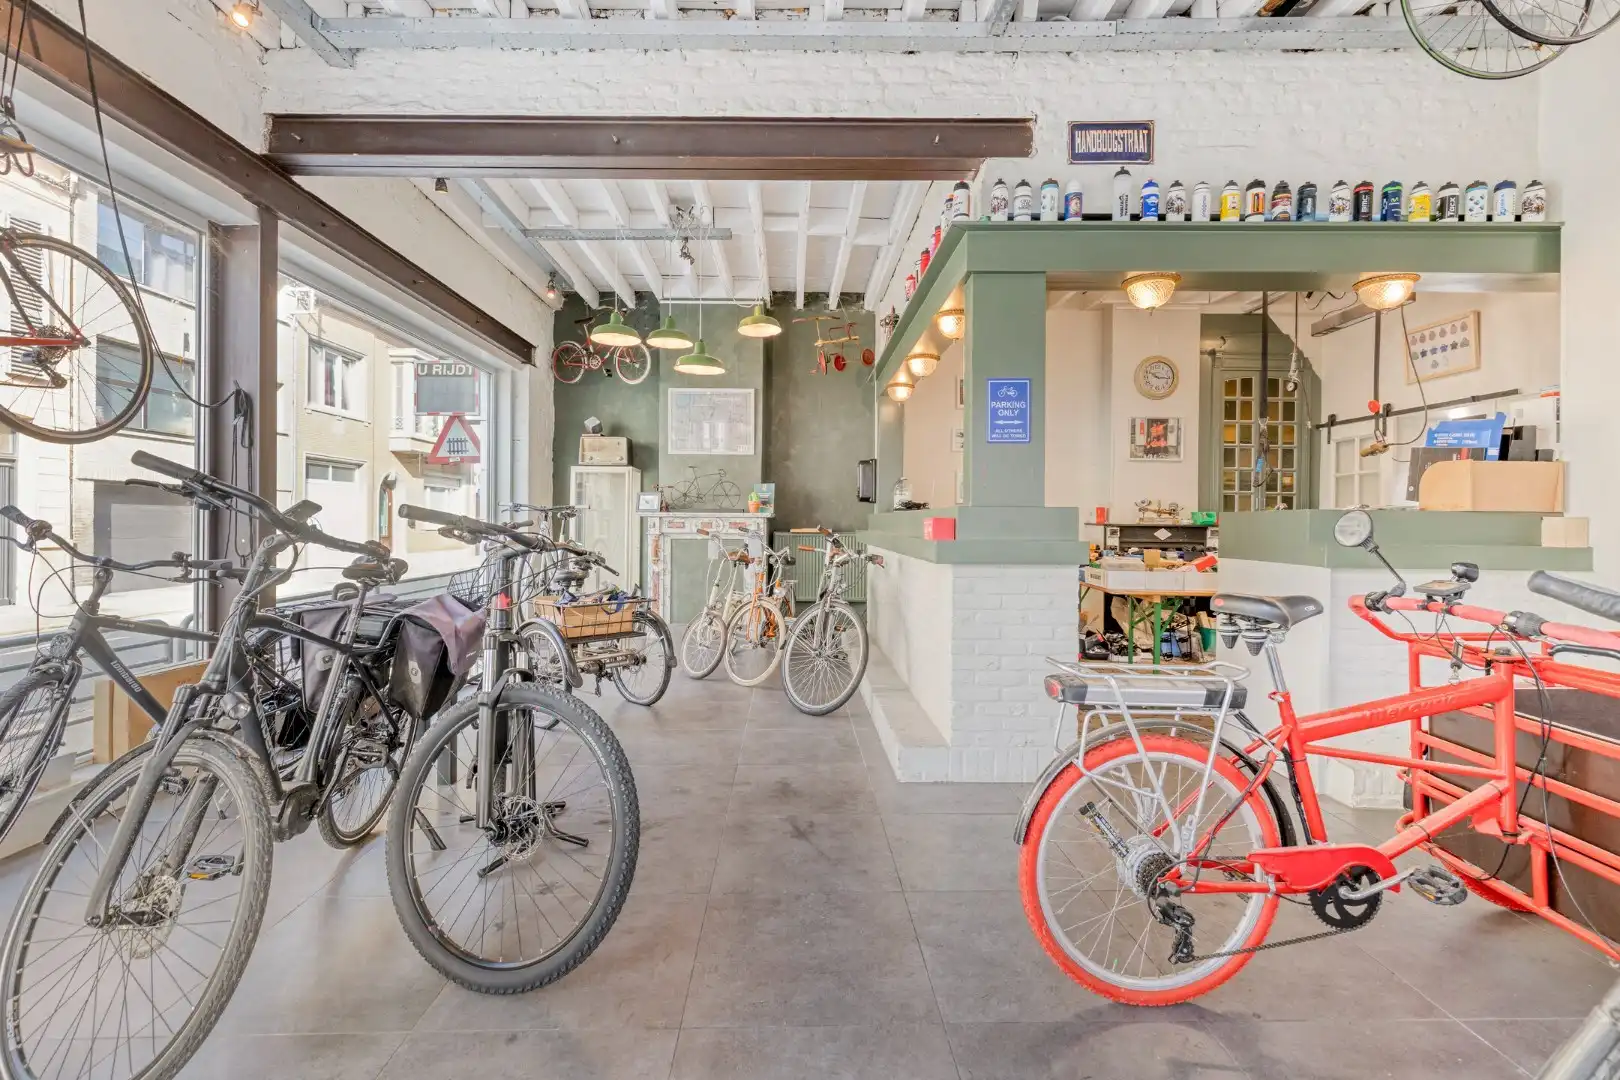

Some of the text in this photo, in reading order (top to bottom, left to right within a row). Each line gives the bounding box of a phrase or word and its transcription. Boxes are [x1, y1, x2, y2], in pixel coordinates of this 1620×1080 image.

[1075, 129, 1148, 153] HANDBOOGSTRAAT
[1447, 196, 1456, 218] Tacx
[417, 364, 473, 376] U RIJDT
[990, 401, 1026, 409] PARKING
[997, 409, 1019, 417] ONLY
